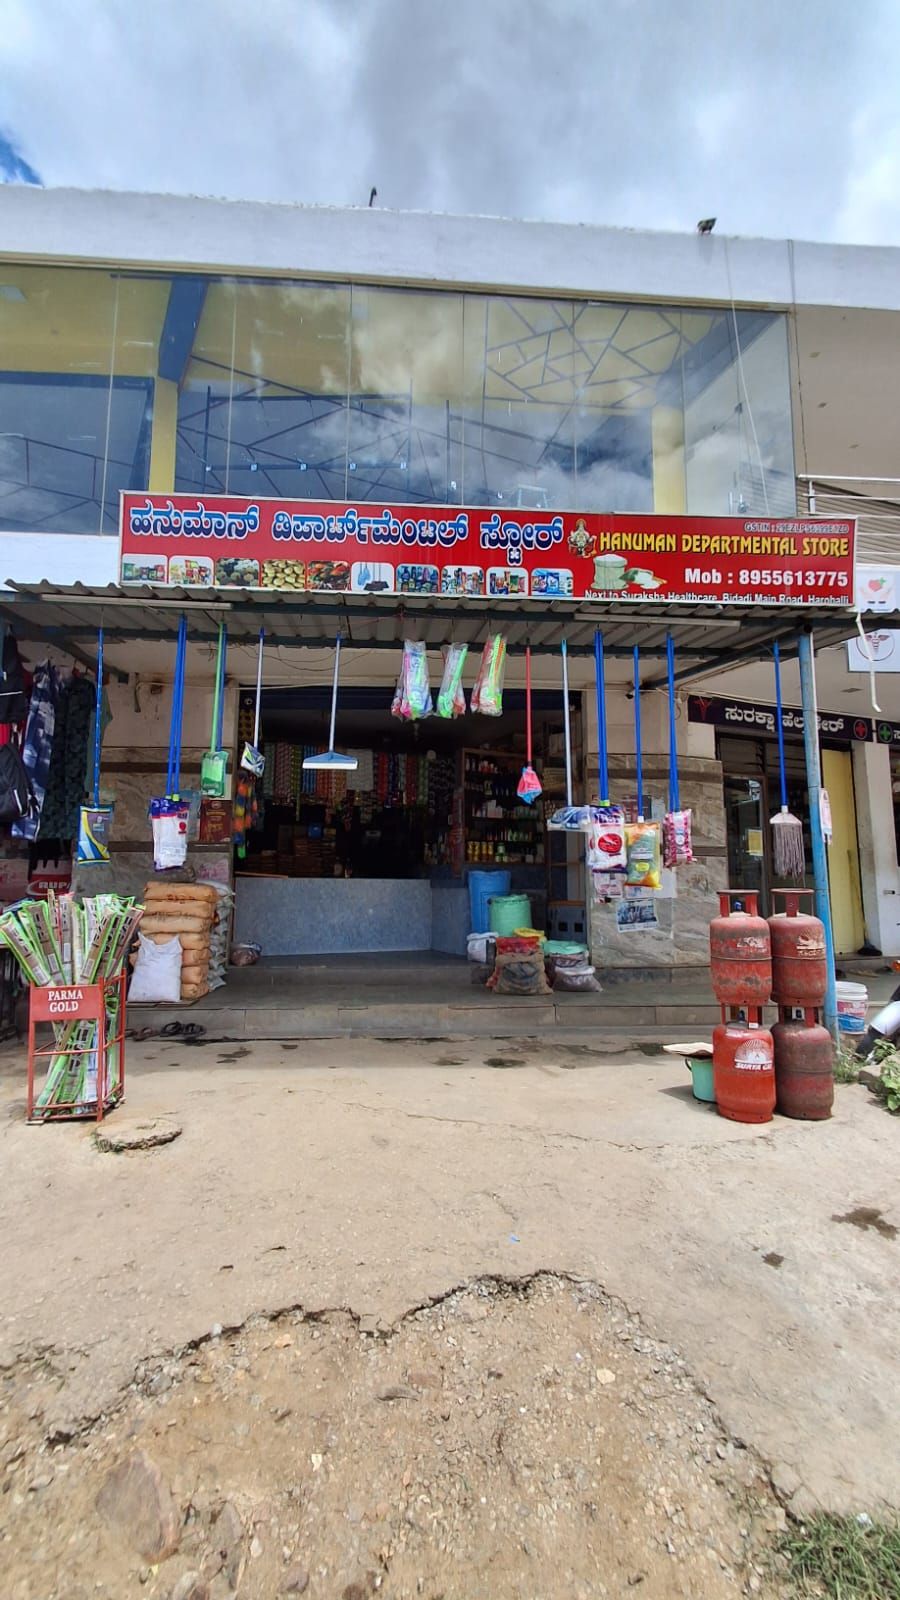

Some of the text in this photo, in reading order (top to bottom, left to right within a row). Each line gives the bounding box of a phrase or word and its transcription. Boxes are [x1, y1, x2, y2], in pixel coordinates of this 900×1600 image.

[130, 499, 260, 540] ಹನುಮಾನ್
[480, 514, 564, 566] ಸ್ಟೋರ್
[744, 521, 770, 533] GSTIN
[600, 533, 849, 557] HANUMAN DEPARTMENTAL STORE
[684, 568, 722, 584] Mob
[739, 569, 848, 587] 8955613775
[621, 590, 665, 600] Suraksha
[722, 592, 752, 602] Bidadi
[755, 593, 776, 603] Main
[47, 989, 84, 1001] PARMA
[49, 1001, 79, 1012] GOLD
